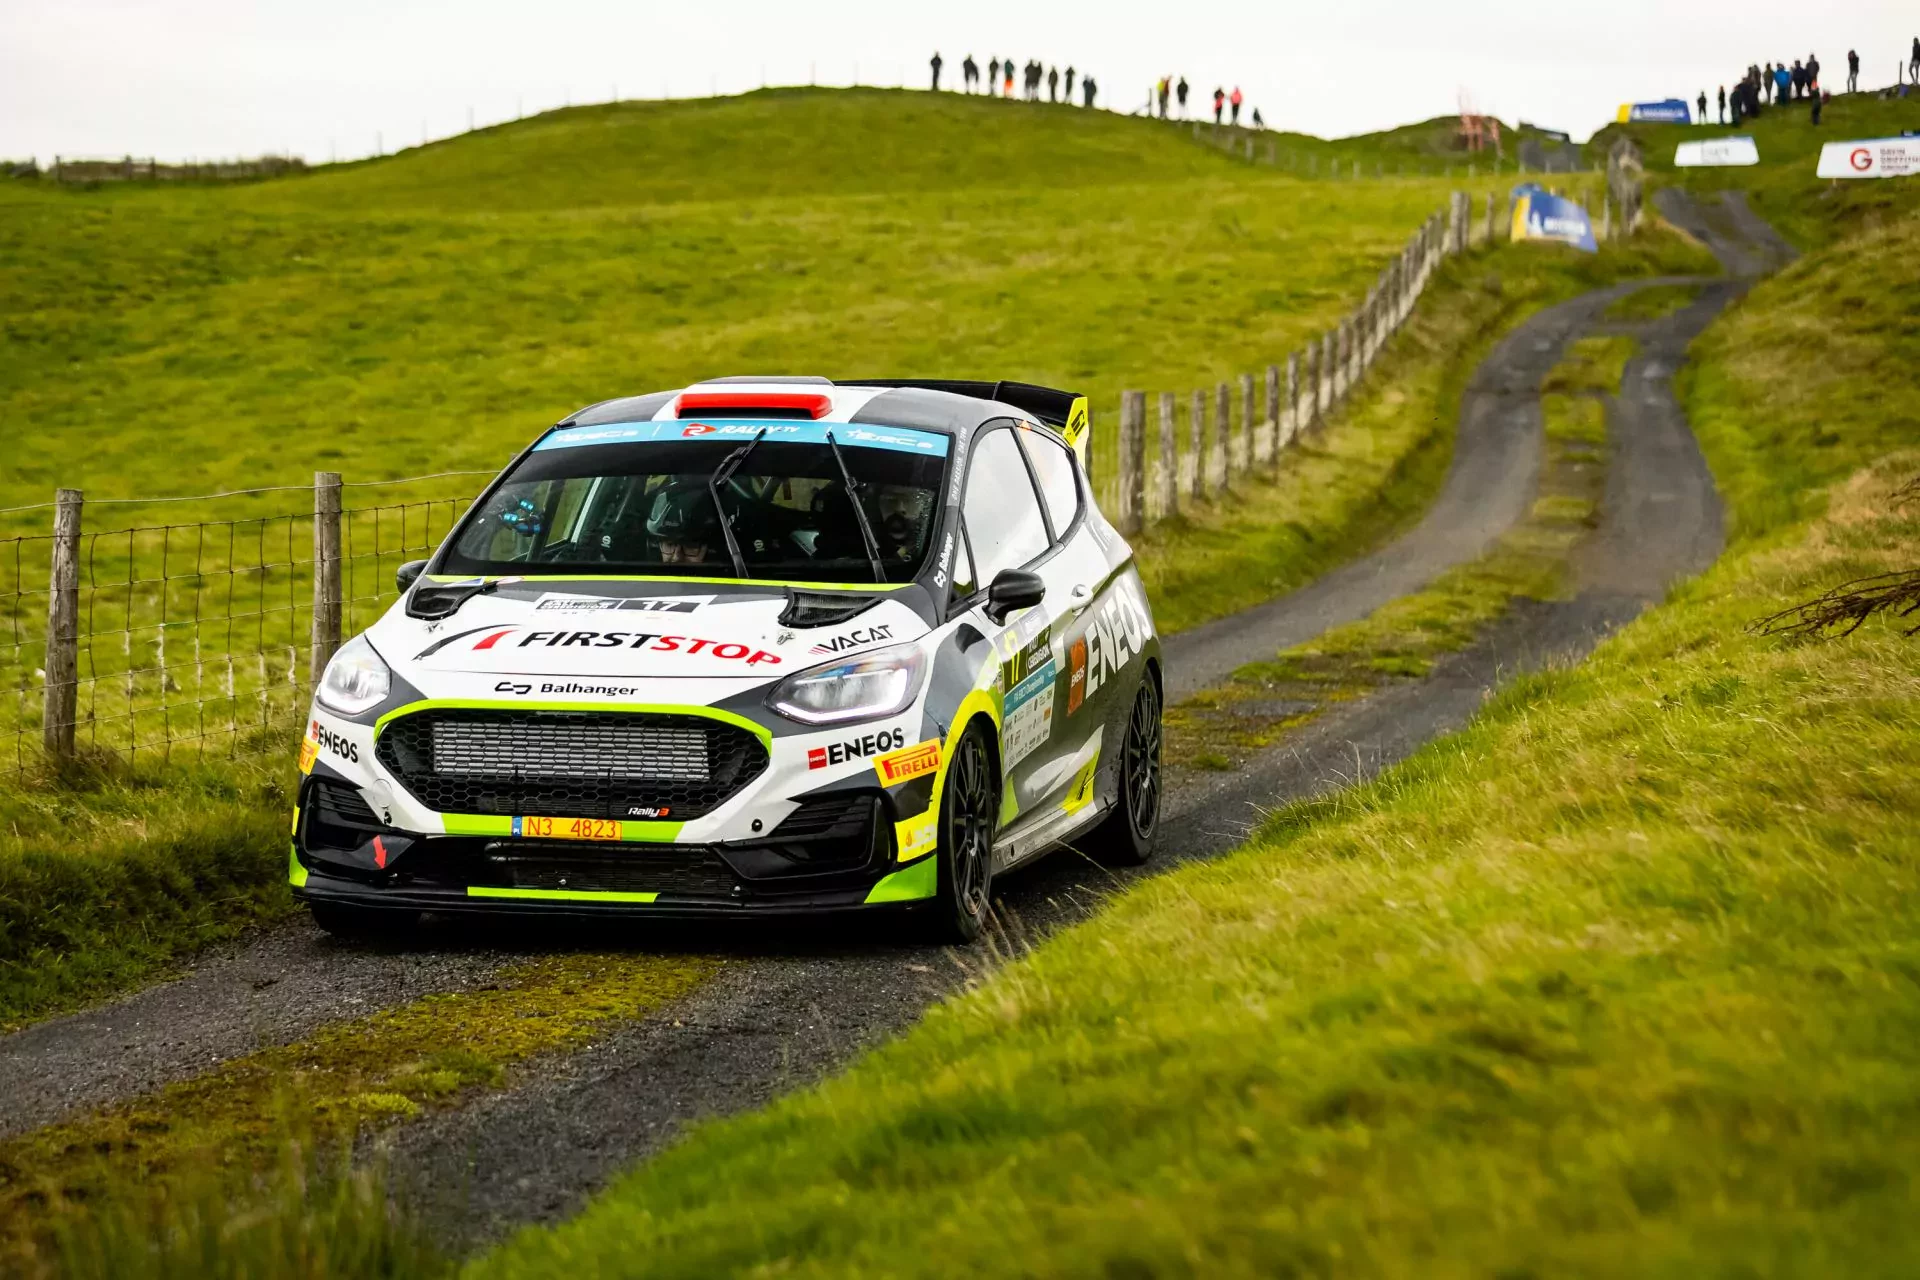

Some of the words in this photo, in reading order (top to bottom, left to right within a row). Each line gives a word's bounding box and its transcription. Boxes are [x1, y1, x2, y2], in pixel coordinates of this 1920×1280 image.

[642, 601, 677, 611] 17
[517, 631, 782, 666] FIRSTSTOP
[817, 624, 894, 652] VACAT
[1085, 572, 1153, 699] ENEOS
[540, 682, 639, 697] Balhanger
[1071, 664, 1085, 688] ENEOS
[318, 724, 359, 764] ENEOS
[827, 727, 904, 766] ENEOS
[882, 745, 939, 780] PIRELLI
[628, 807, 670, 818] Rally3
[527, 816, 553, 836] N3
[570, 819, 616, 839] 4823
